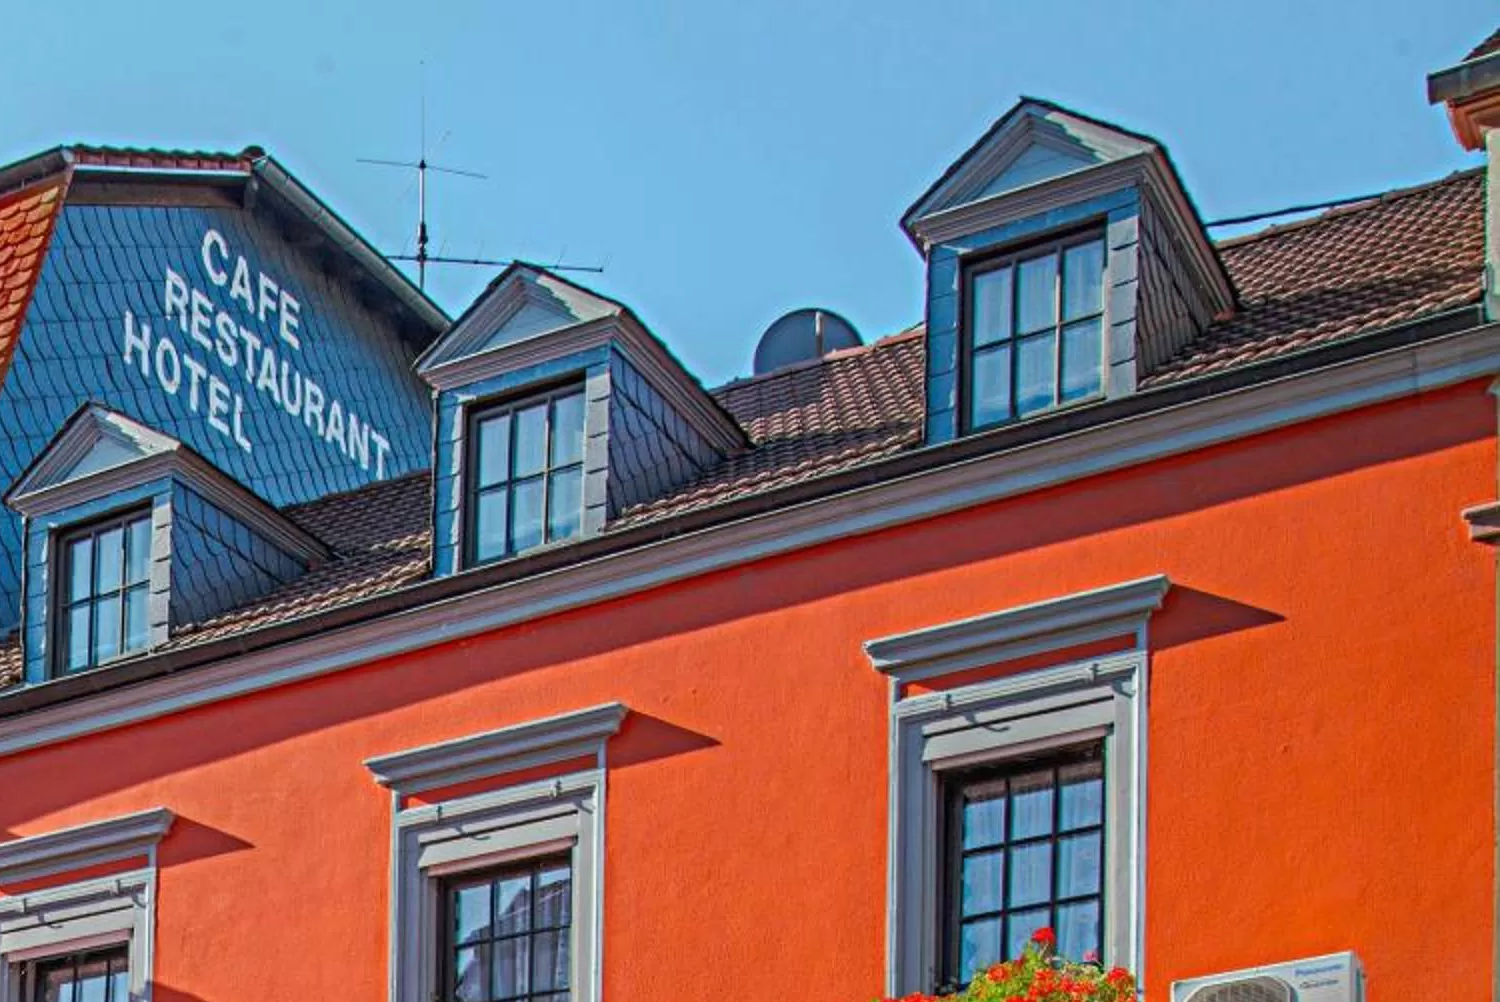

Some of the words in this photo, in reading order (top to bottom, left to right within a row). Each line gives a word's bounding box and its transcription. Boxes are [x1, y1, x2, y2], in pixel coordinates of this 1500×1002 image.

[202, 229, 301, 350] CAFE
[123, 311, 251, 453] HOTEL
[165, 268, 390, 480] RESTAURANT
